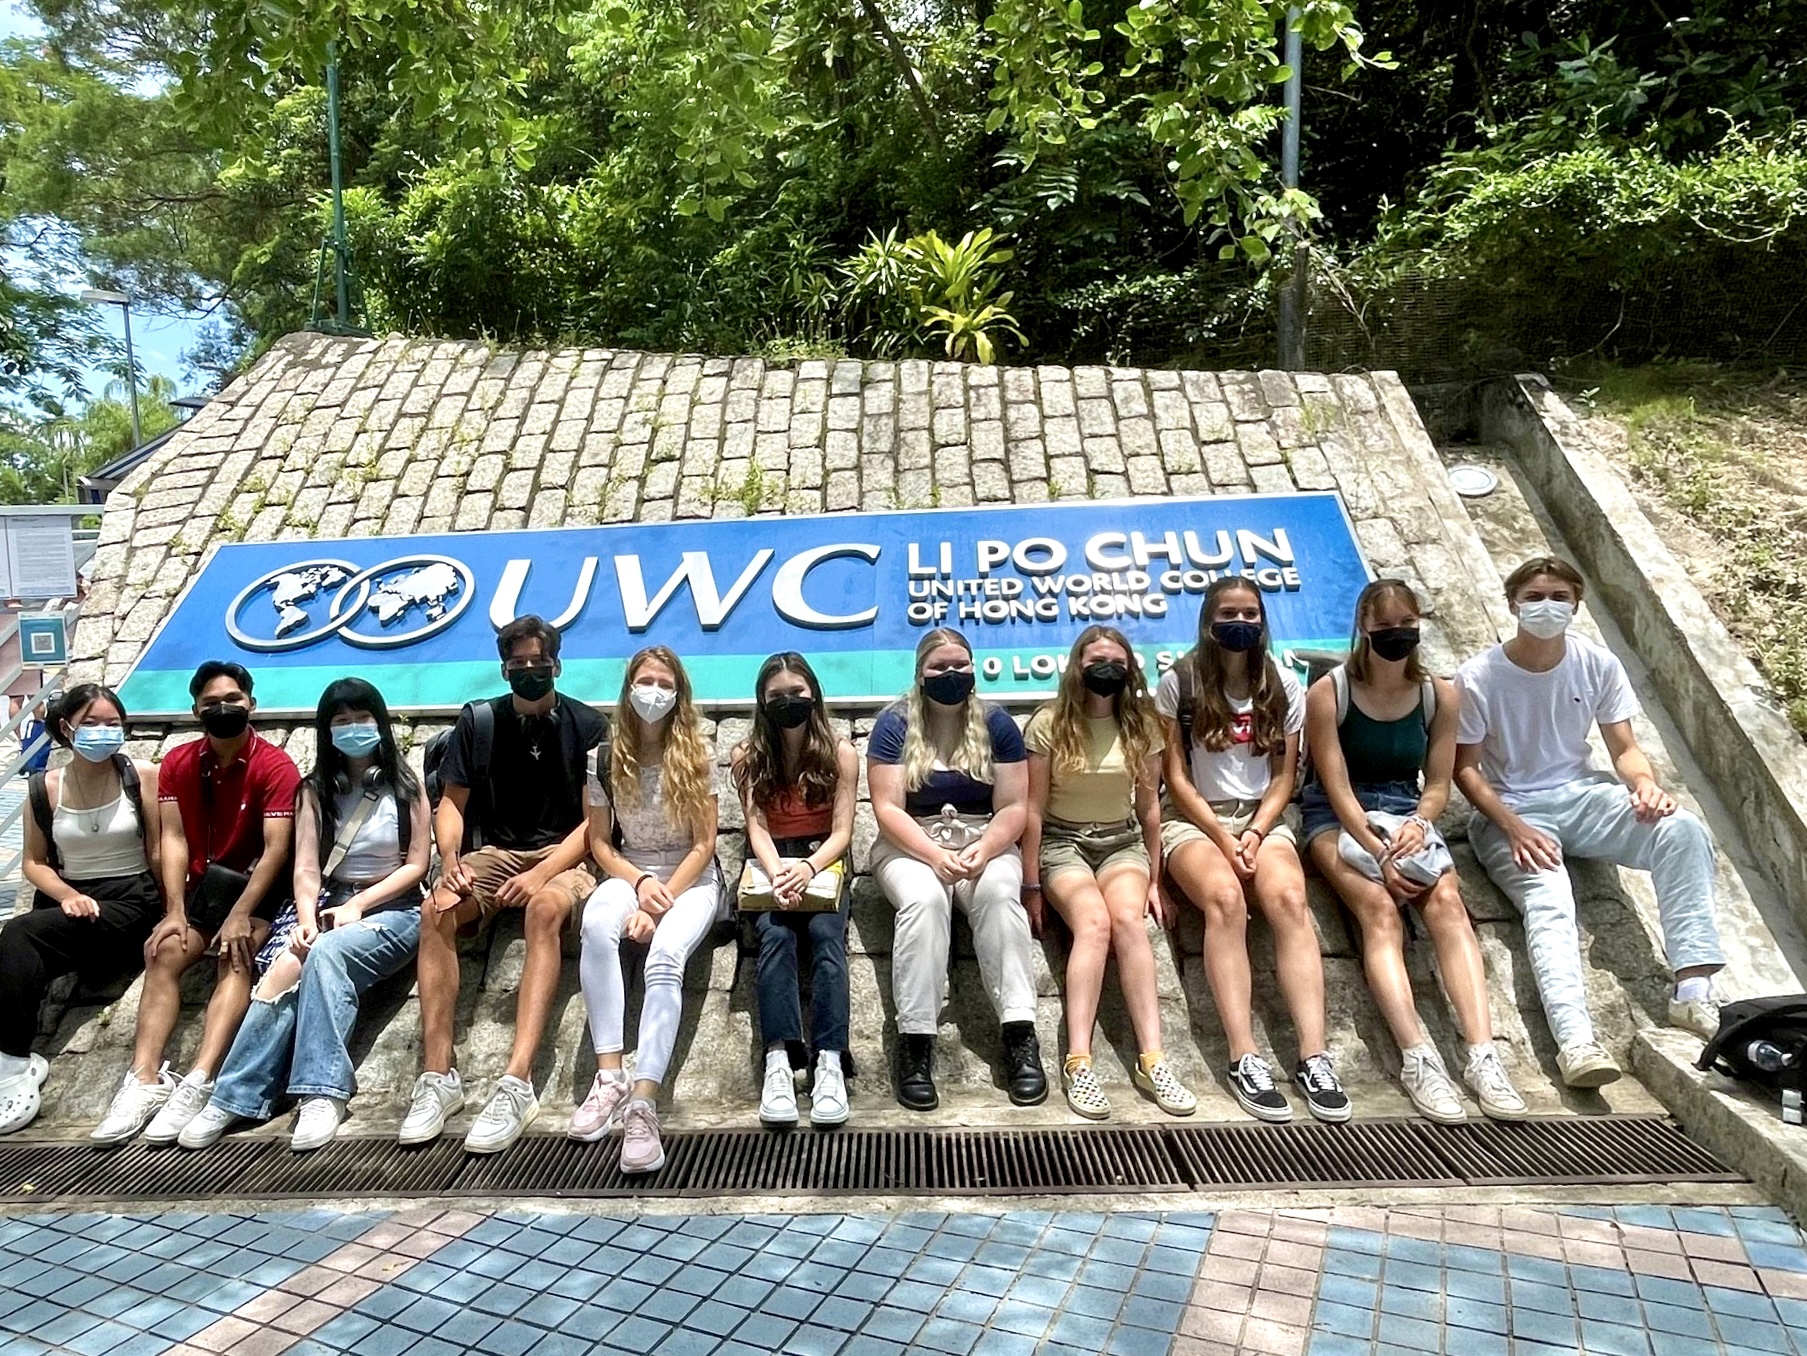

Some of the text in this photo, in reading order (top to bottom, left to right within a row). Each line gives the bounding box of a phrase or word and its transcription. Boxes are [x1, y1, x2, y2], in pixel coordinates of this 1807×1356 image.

[907, 527, 1296, 576] LI PO CHUN
[489, 543, 882, 629] UWC
[908, 566, 1302, 600] UNITED WORLD COEGE
[906, 591, 1169, 622] OF HONG KONG
[974, 655, 1003, 676] 0
